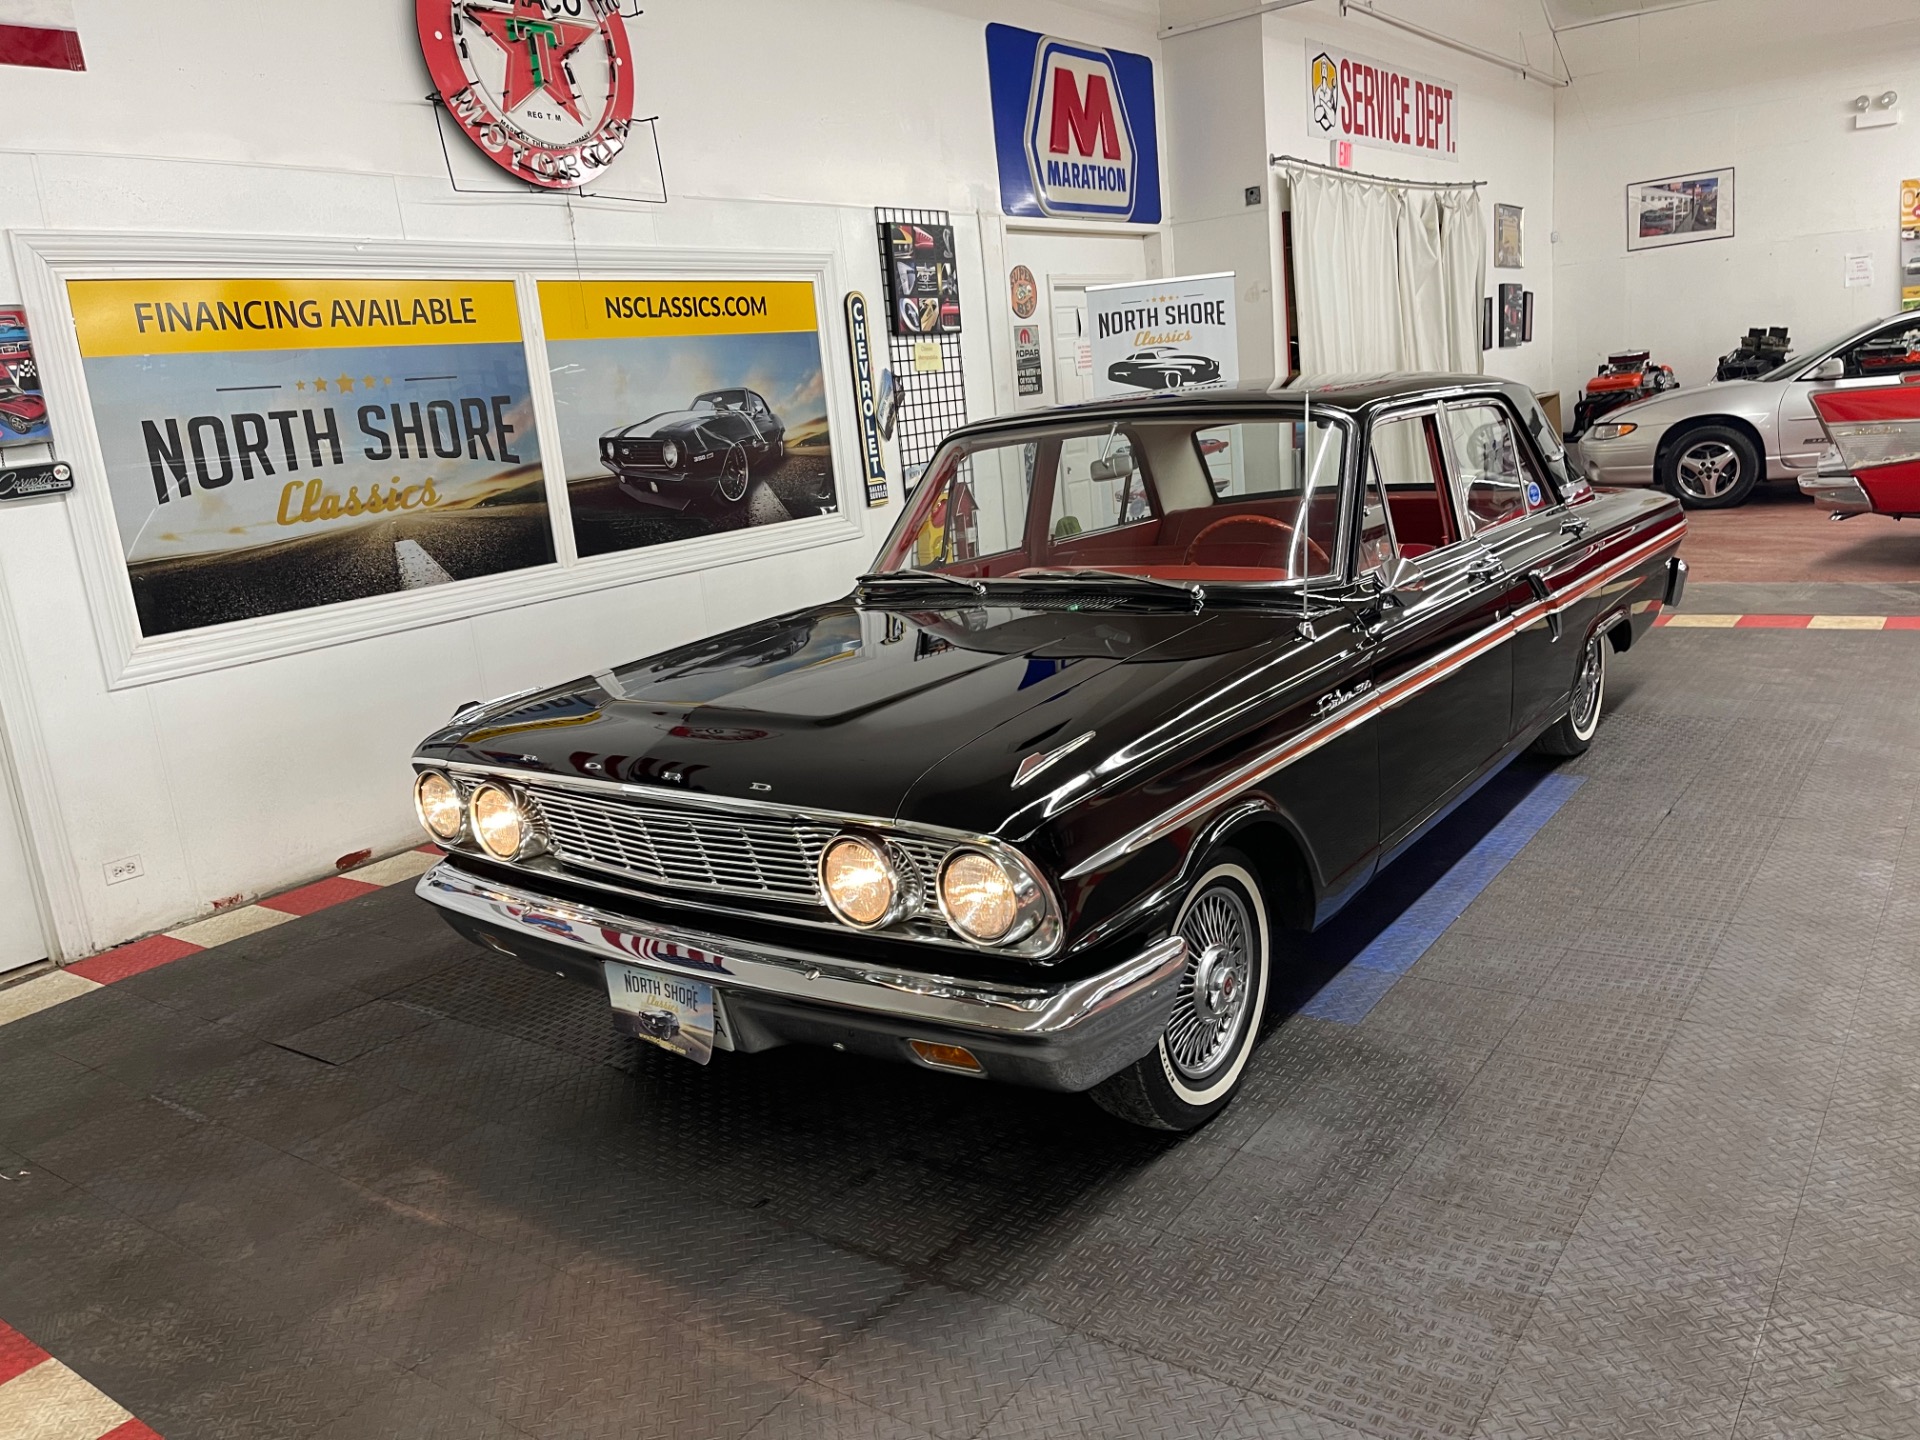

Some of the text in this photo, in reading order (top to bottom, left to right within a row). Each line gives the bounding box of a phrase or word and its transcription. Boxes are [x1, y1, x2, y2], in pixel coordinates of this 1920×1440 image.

[1340, 58, 1456, 154] SERVICE DEPT.
[1047, 160, 1126, 192] MARATHON
[134, 298, 477, 333] FINANCING AVAILABLE
[605, 296, 767, 318] NSCLASSICS.COM
[1098, 300, 1226, 339] NORTH SHORE
[1134, 330, 1193, 347] Classics
[852, 302, 879, 475] CHEVROLET
[141, 396, 521, 504] NORTH SHORE
[0, 472, 56, 495] Corvette
[276, 475, 443, 526] Classics
[624, 972, 699, 1013] NORTH SHORE
[646, 995, 680, 1013] Classics
